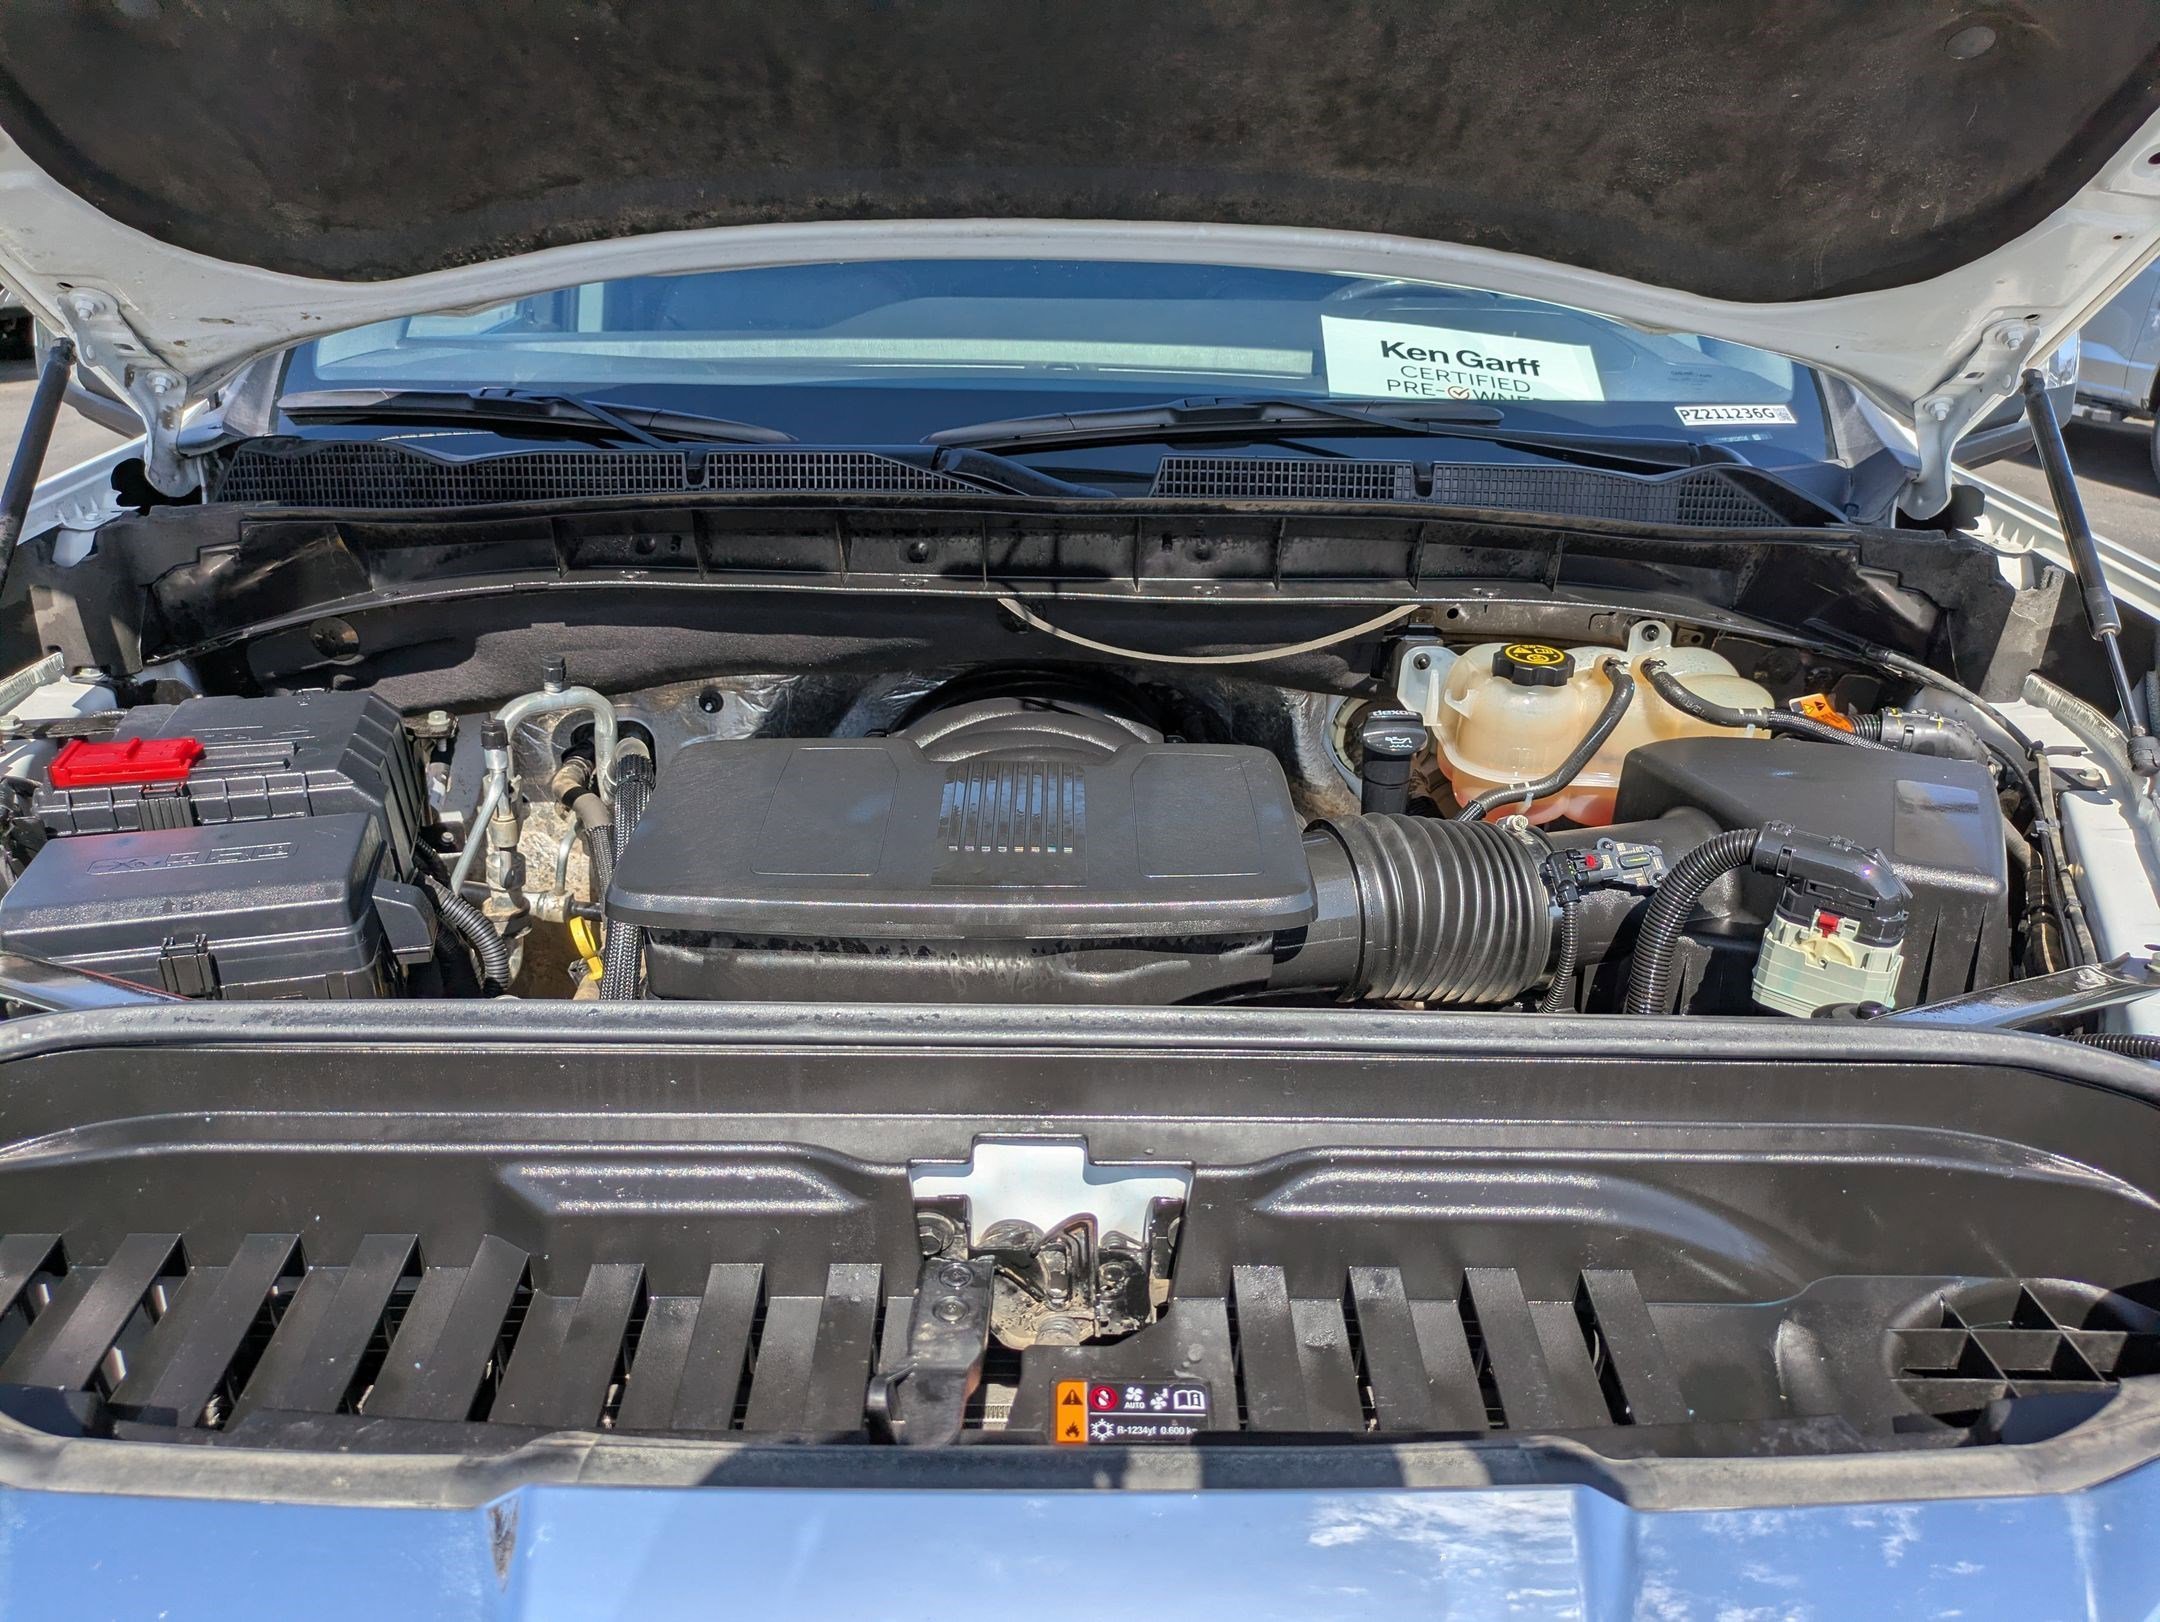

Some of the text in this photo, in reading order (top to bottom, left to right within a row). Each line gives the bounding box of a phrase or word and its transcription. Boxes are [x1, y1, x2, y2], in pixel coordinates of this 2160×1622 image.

[1381, 340, 1540, 376] Ken Garff
[1401, 365, 1531, 393] CERTIFIED
[1679, 407, 1776, 420] PZ211236G
[1124, 1401, 1145, 1409] AUTO
[1117, 1425, 1156, 1436] R-1234yf
[1160, 1426, 1185, 1435] 0.600
